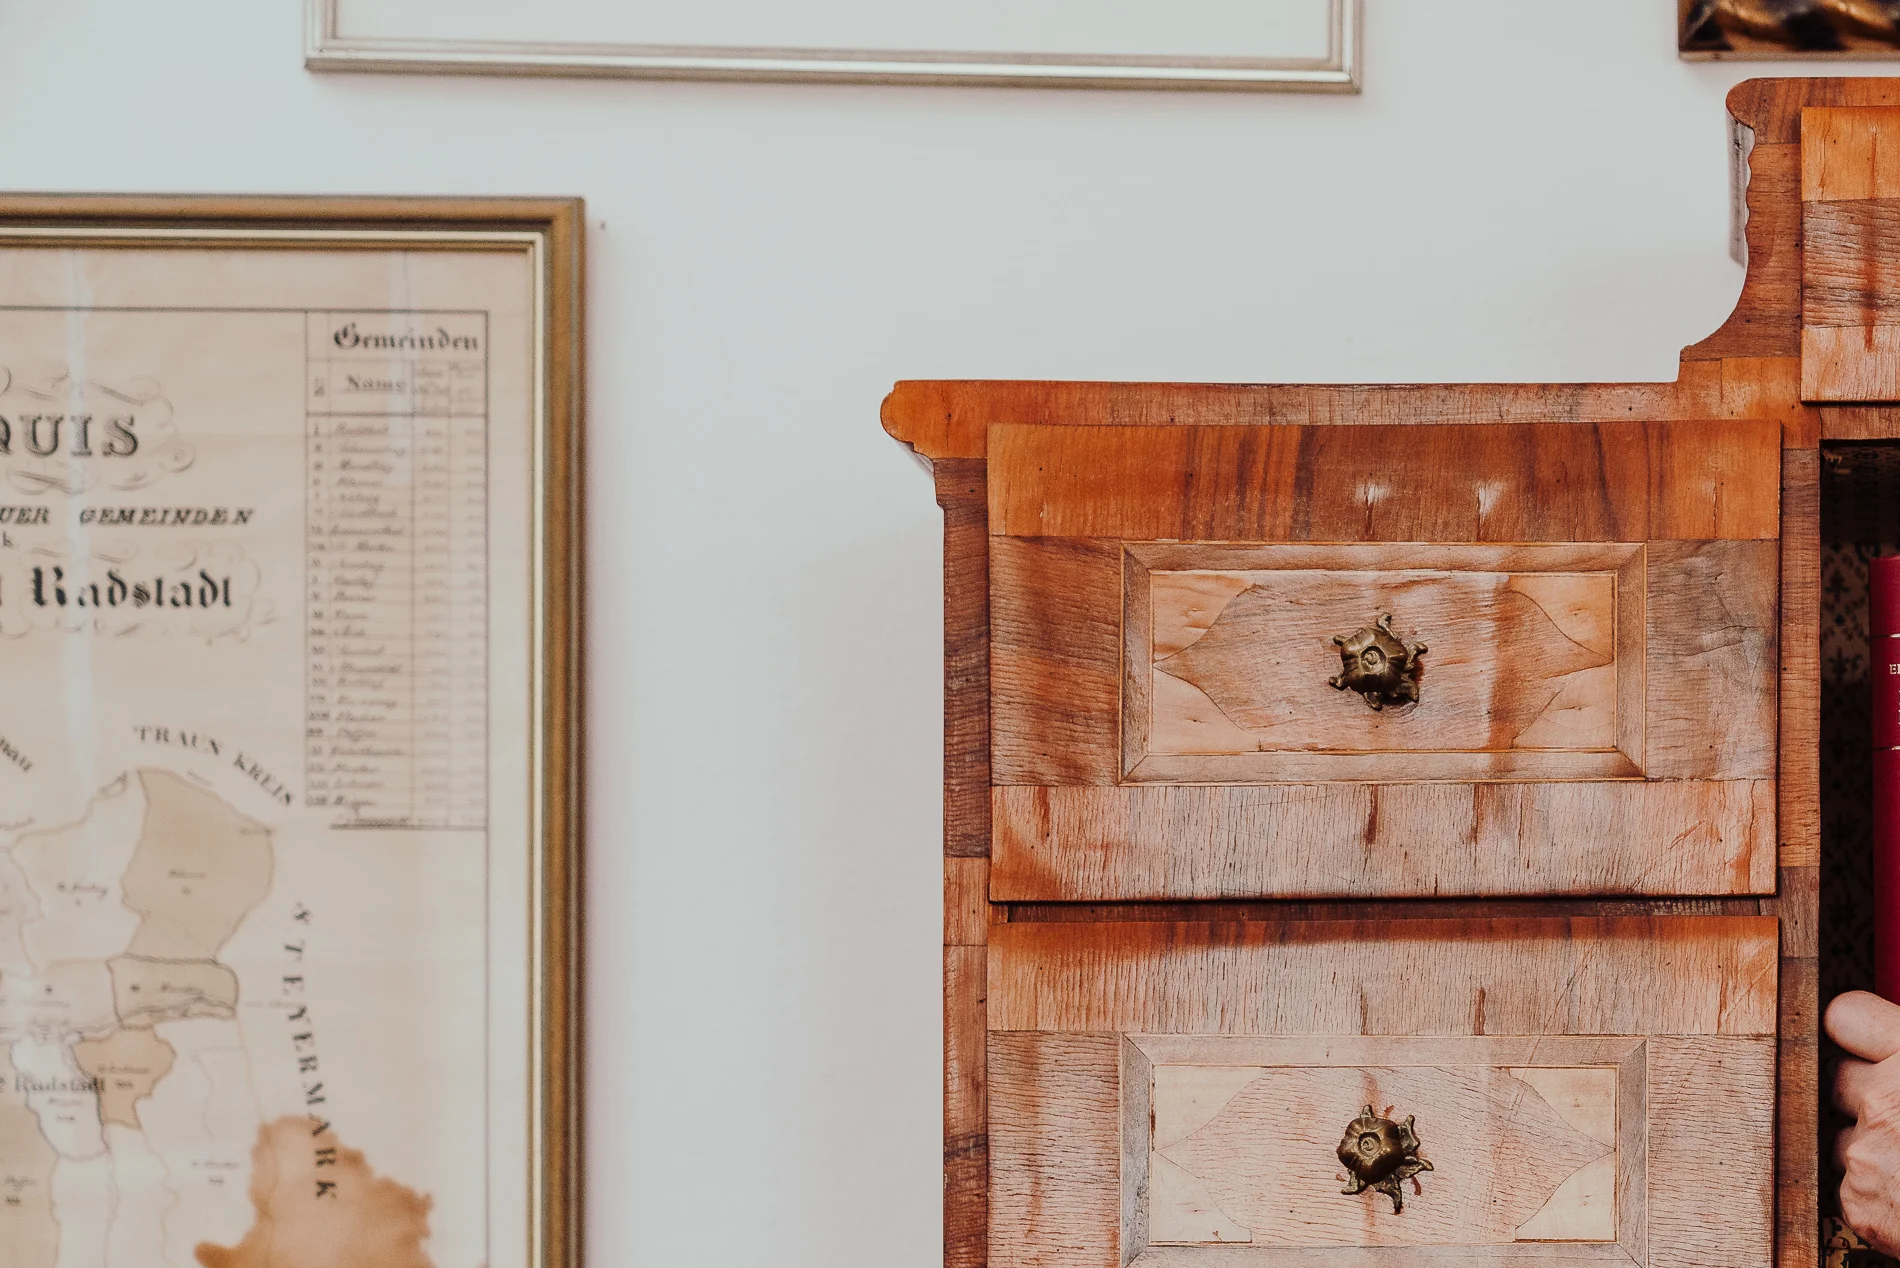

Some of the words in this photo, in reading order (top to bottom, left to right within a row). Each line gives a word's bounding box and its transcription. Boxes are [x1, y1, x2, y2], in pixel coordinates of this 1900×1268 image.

[333, 321, 479, 351] Gemeinden
[0, 413, 140, 458] UIS
[78, 506, 255, 527] GEMEINDEN
[30, 563, 233, 609] Radstadt
